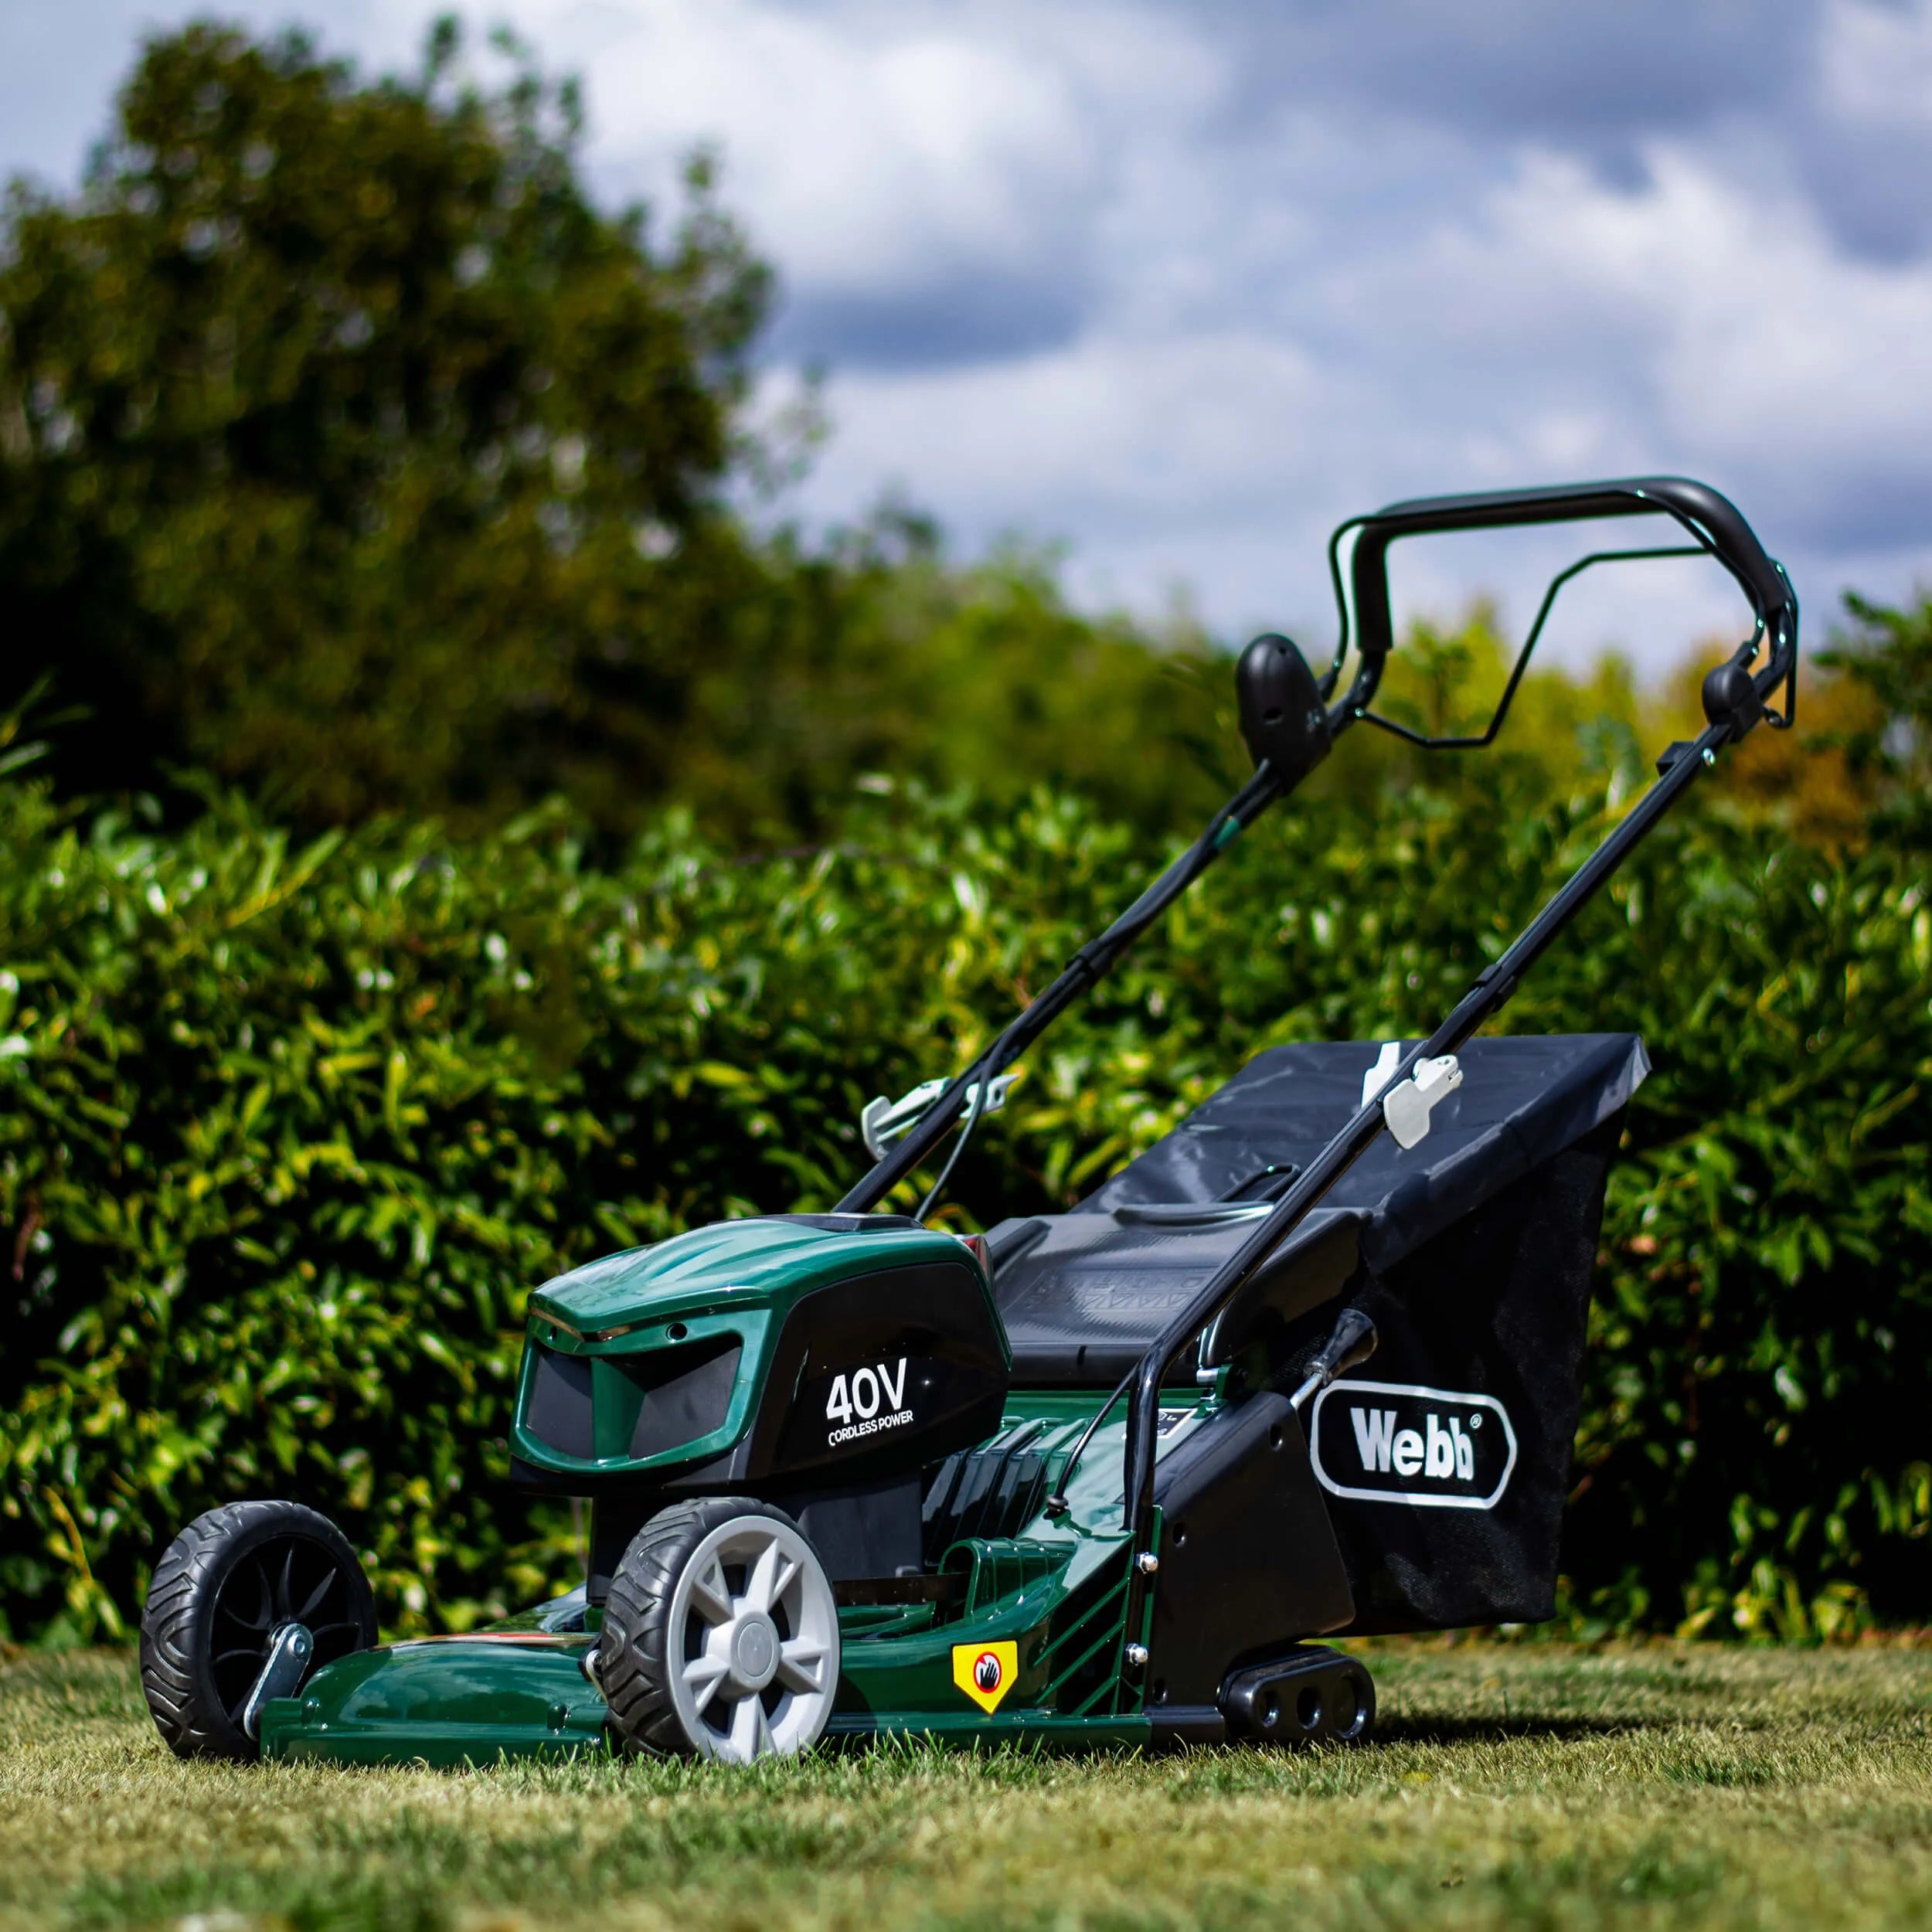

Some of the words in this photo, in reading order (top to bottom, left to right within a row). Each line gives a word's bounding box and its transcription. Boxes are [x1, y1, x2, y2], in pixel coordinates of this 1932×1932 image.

[826, 1358, 907, 1424] 40V
[828, 1419, 878, 1447] CORDLESS
[878, 1409, 914, 1430] POWER
